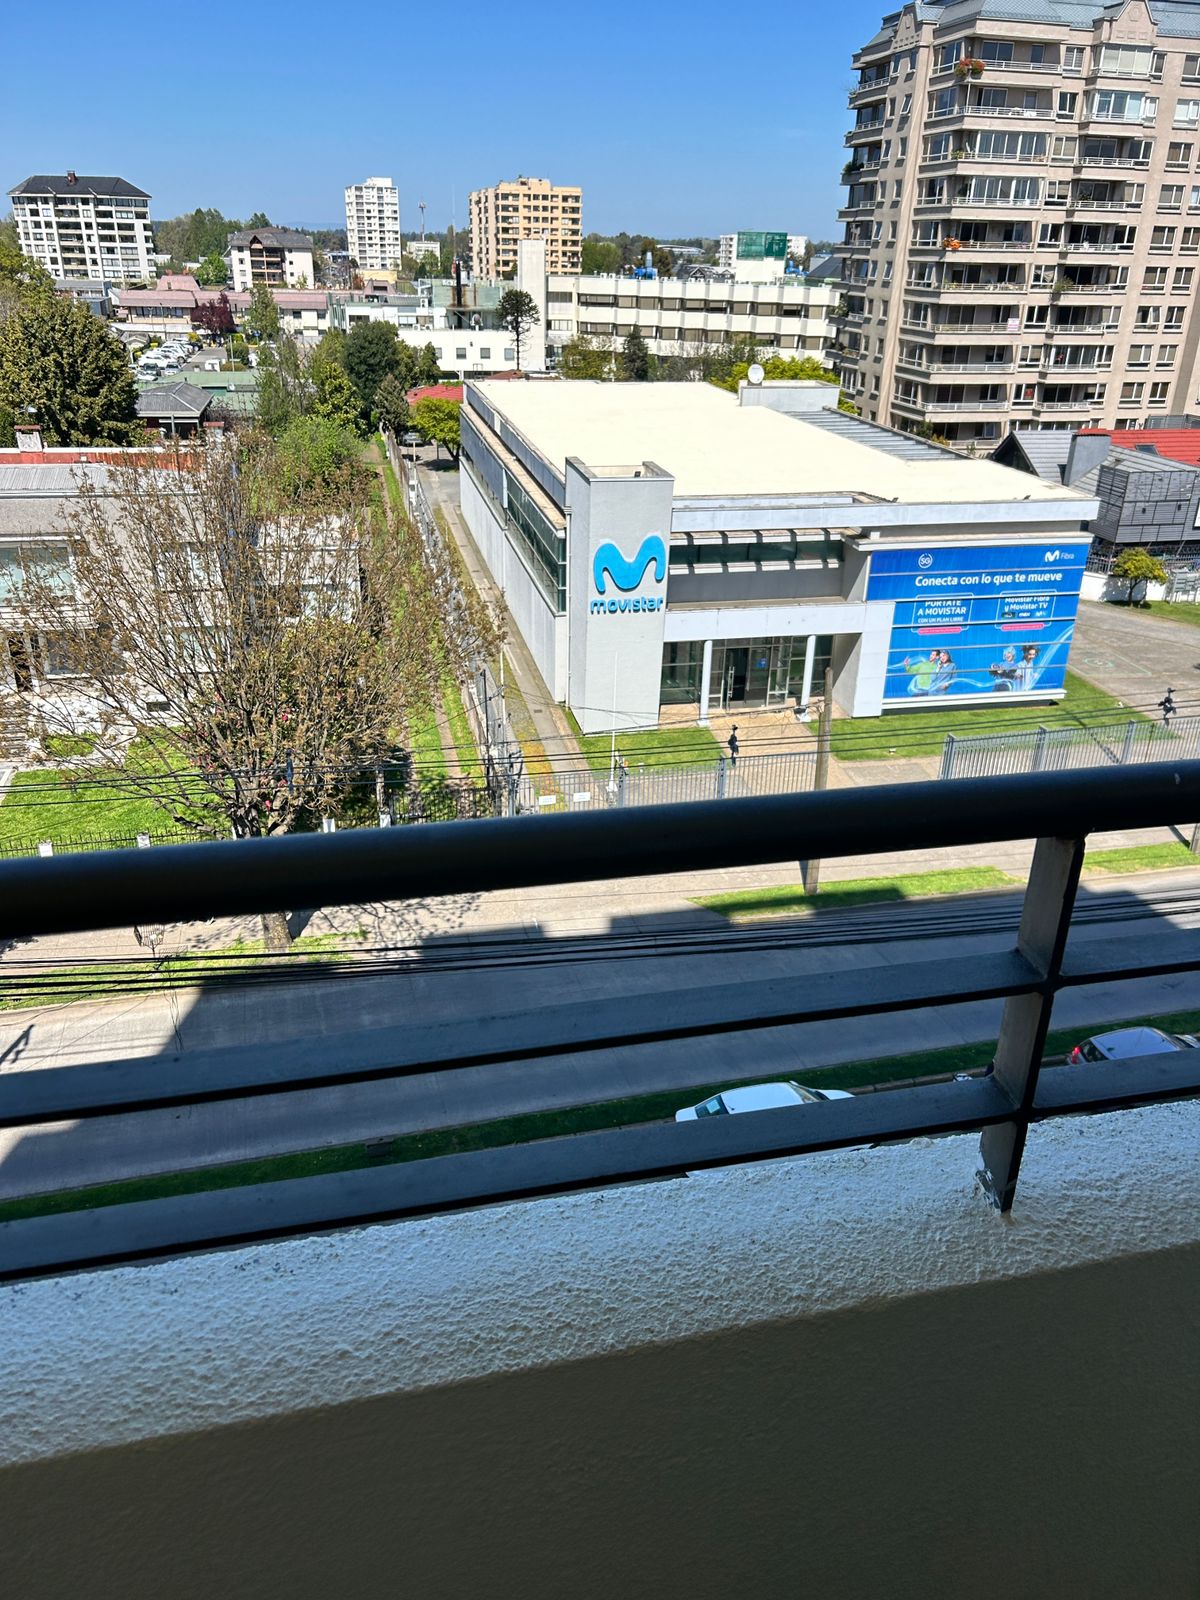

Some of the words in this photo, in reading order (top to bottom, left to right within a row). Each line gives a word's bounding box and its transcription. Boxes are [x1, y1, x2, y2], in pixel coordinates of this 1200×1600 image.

[915, 576, 958, 586] Conecta
[960, 576, 979, 585] con
[981, 573, 992, 584] lo
[993, 574, 1013, 586] que
[1015, 573, 1026, 582] te
[1027, 572, 1063, 582] mueve
[590, 597, 663, 615] movistar
[917, 608, 924, 616] A
[925, 607, 967, 616] MOVISTAR
